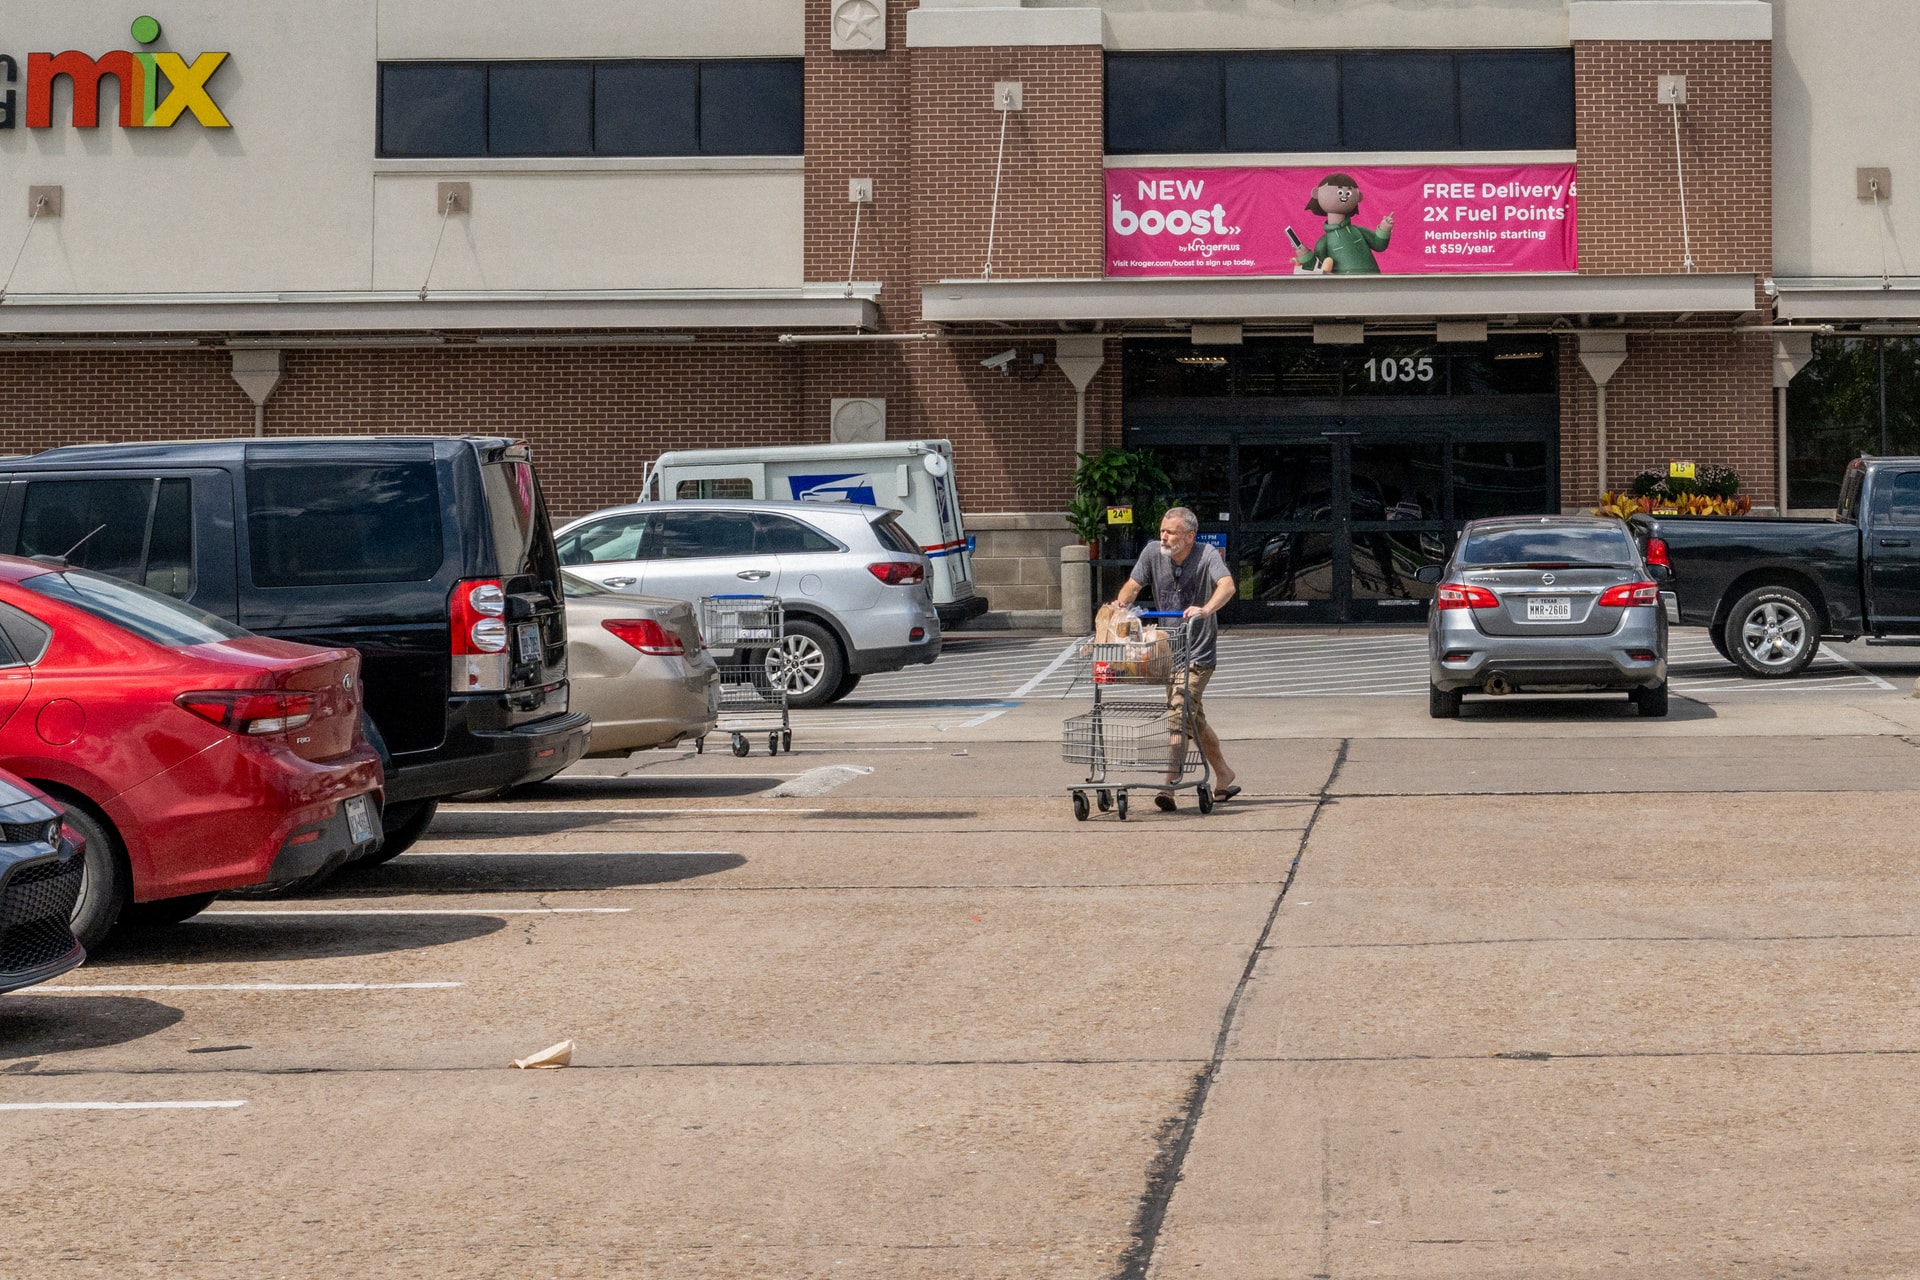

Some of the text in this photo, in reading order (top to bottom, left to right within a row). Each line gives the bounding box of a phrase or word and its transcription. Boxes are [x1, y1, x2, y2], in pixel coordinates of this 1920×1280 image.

[1138, 180, 1204, 200] NEW
[1423, 183, 1475, 199] FREE
[1482, 182, 1563, 200] Delivery
[1112, 194, 1229, 236] boost
[1423, 206, 1449, 222] 2X
[1455, 205, 1497, 221] Fuel
[1425, 229, 1546, 241] Membership starting
[1424, 243, 1496, 255] at $59/year.
[1130, 259, 1194, 268] Kroger.com/boost
[1206, 259, 1220, 267] sign
[1364, 357, 1434, 382] 1035
